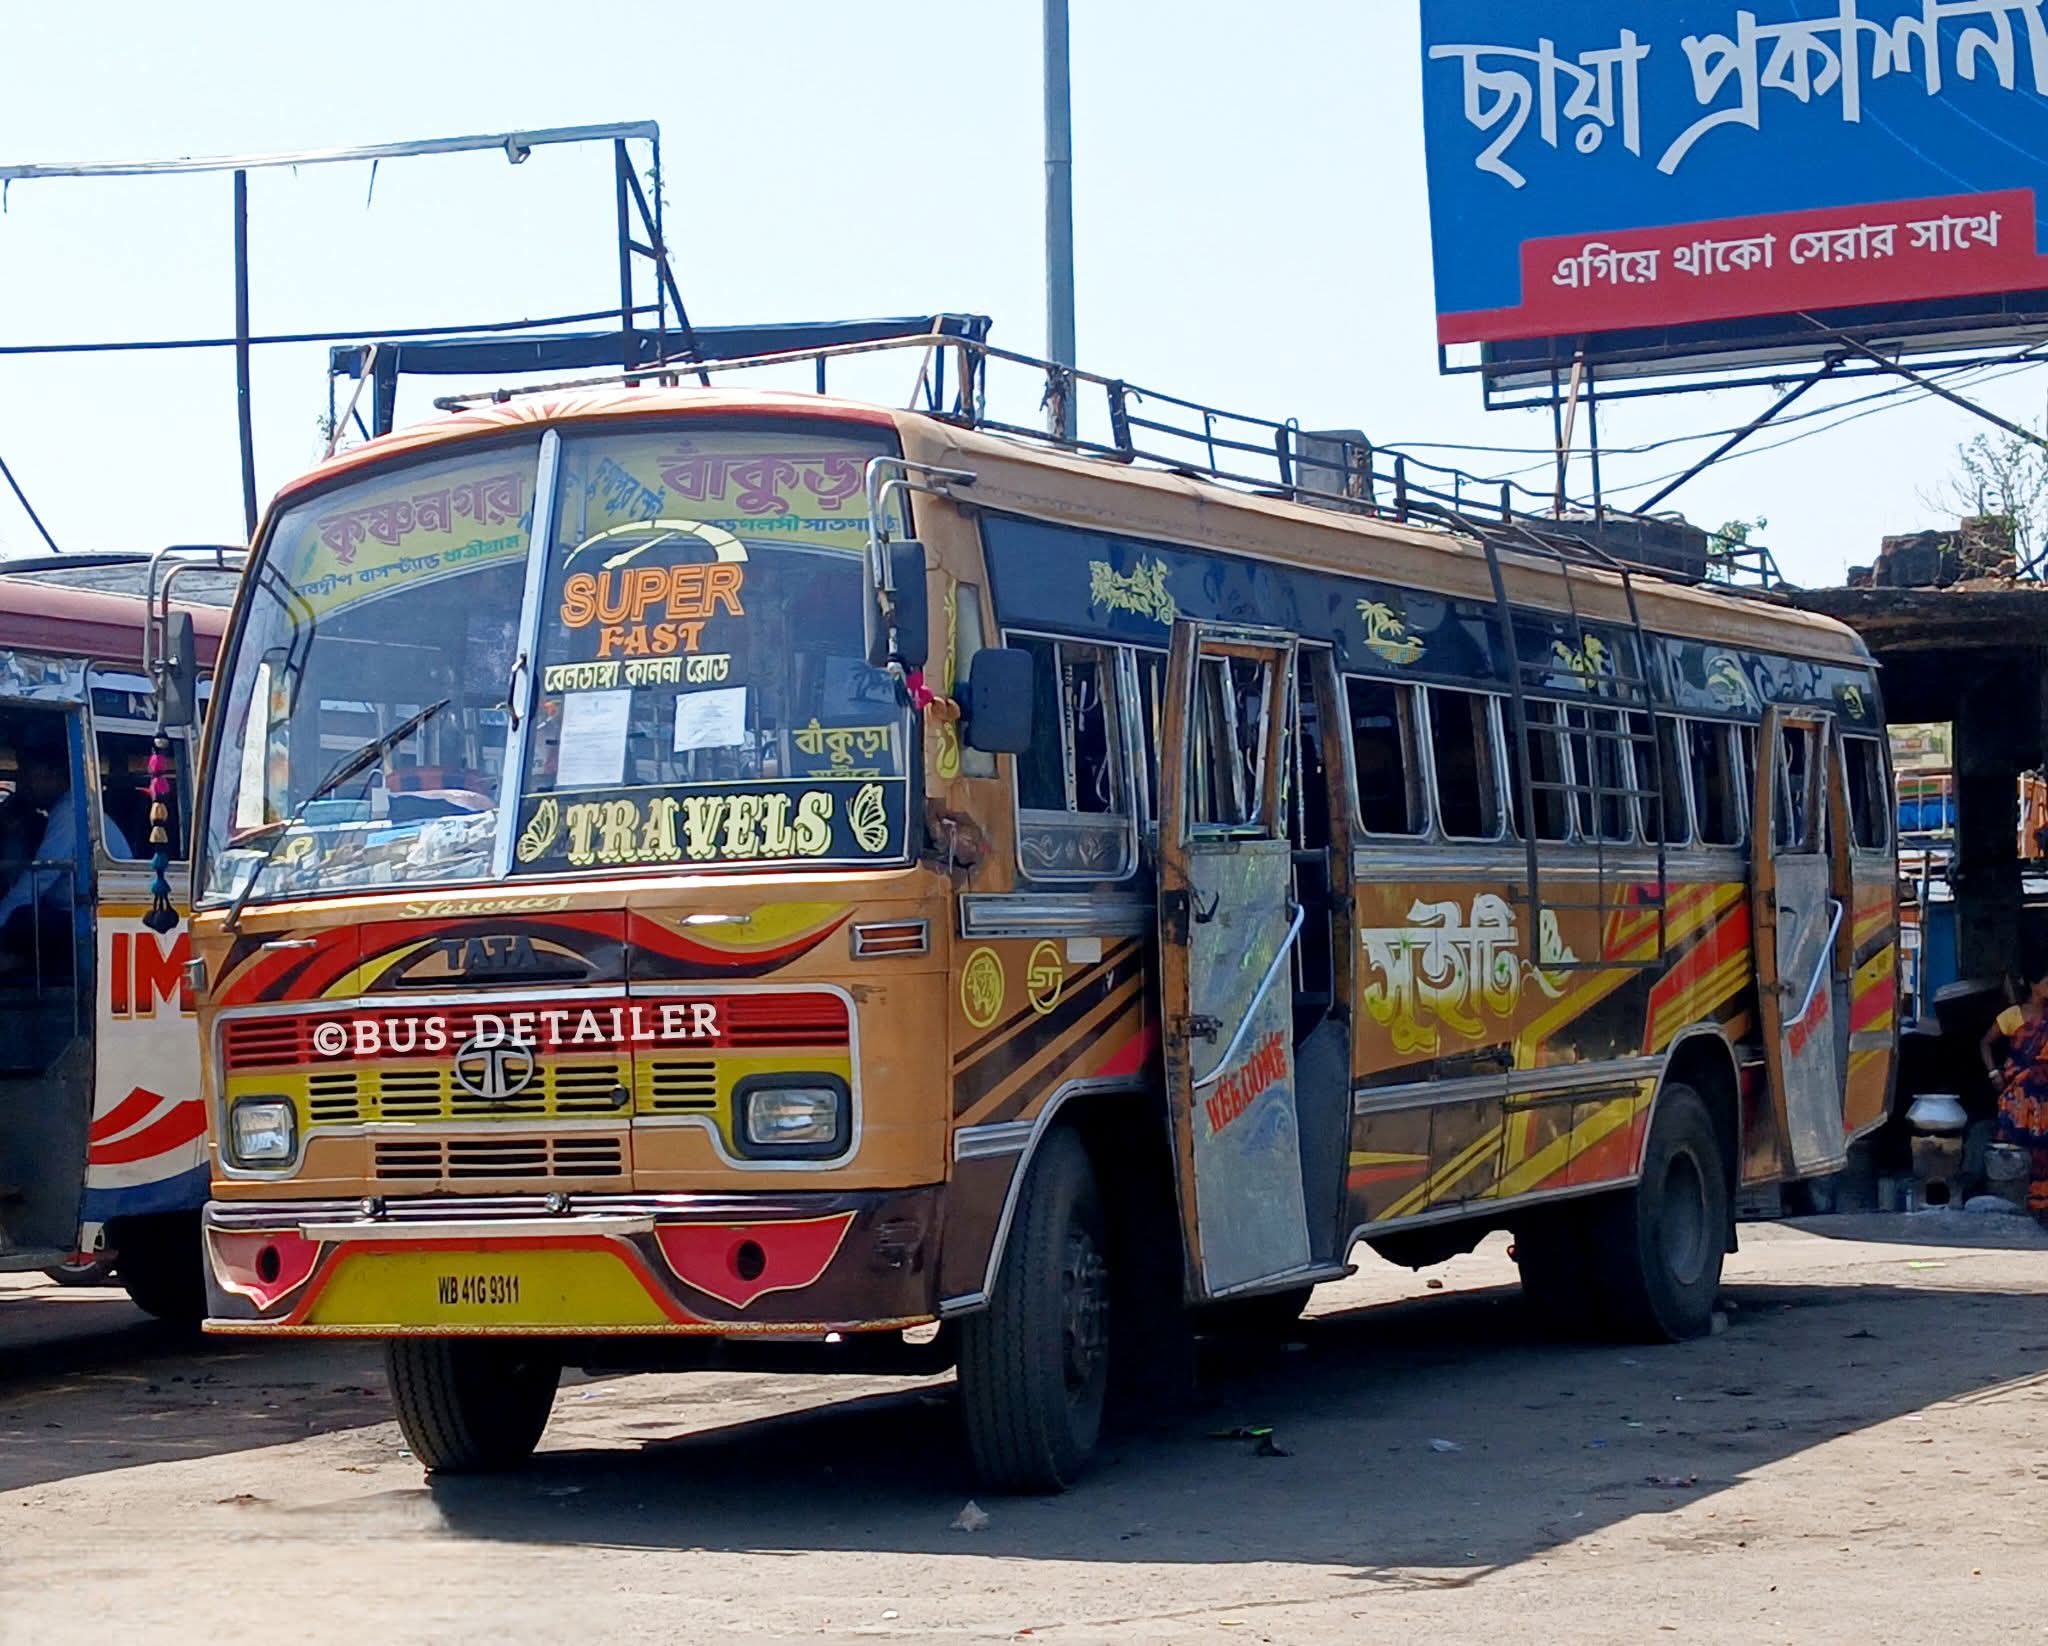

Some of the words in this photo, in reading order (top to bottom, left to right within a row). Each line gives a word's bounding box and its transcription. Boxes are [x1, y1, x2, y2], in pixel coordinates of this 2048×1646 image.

[1428, 28, 1651, 189] ছায়া
[1552, 242, 1660, 289] এগিয়ে
[1673, 233, 1776, 277] থাকো
[1789, 224, 1898, 264] সেরার
[1907, 210, 2002, 253] সাথে
[561, 562, 745, 628] SUPER
[597, 621, 705, 657] FAST
[792, 717, 889, 765] বাঁকুড়া
[566, 791, 834, 866] TRAVELS
[111, 932, 199, 1020] IM
[438, 934, 537, 970] TATA
[438, 1275, 459, 1304] WB
[462, 1275, 487, 1304] 41G
[489, 1275, 520, 1304] 9311
